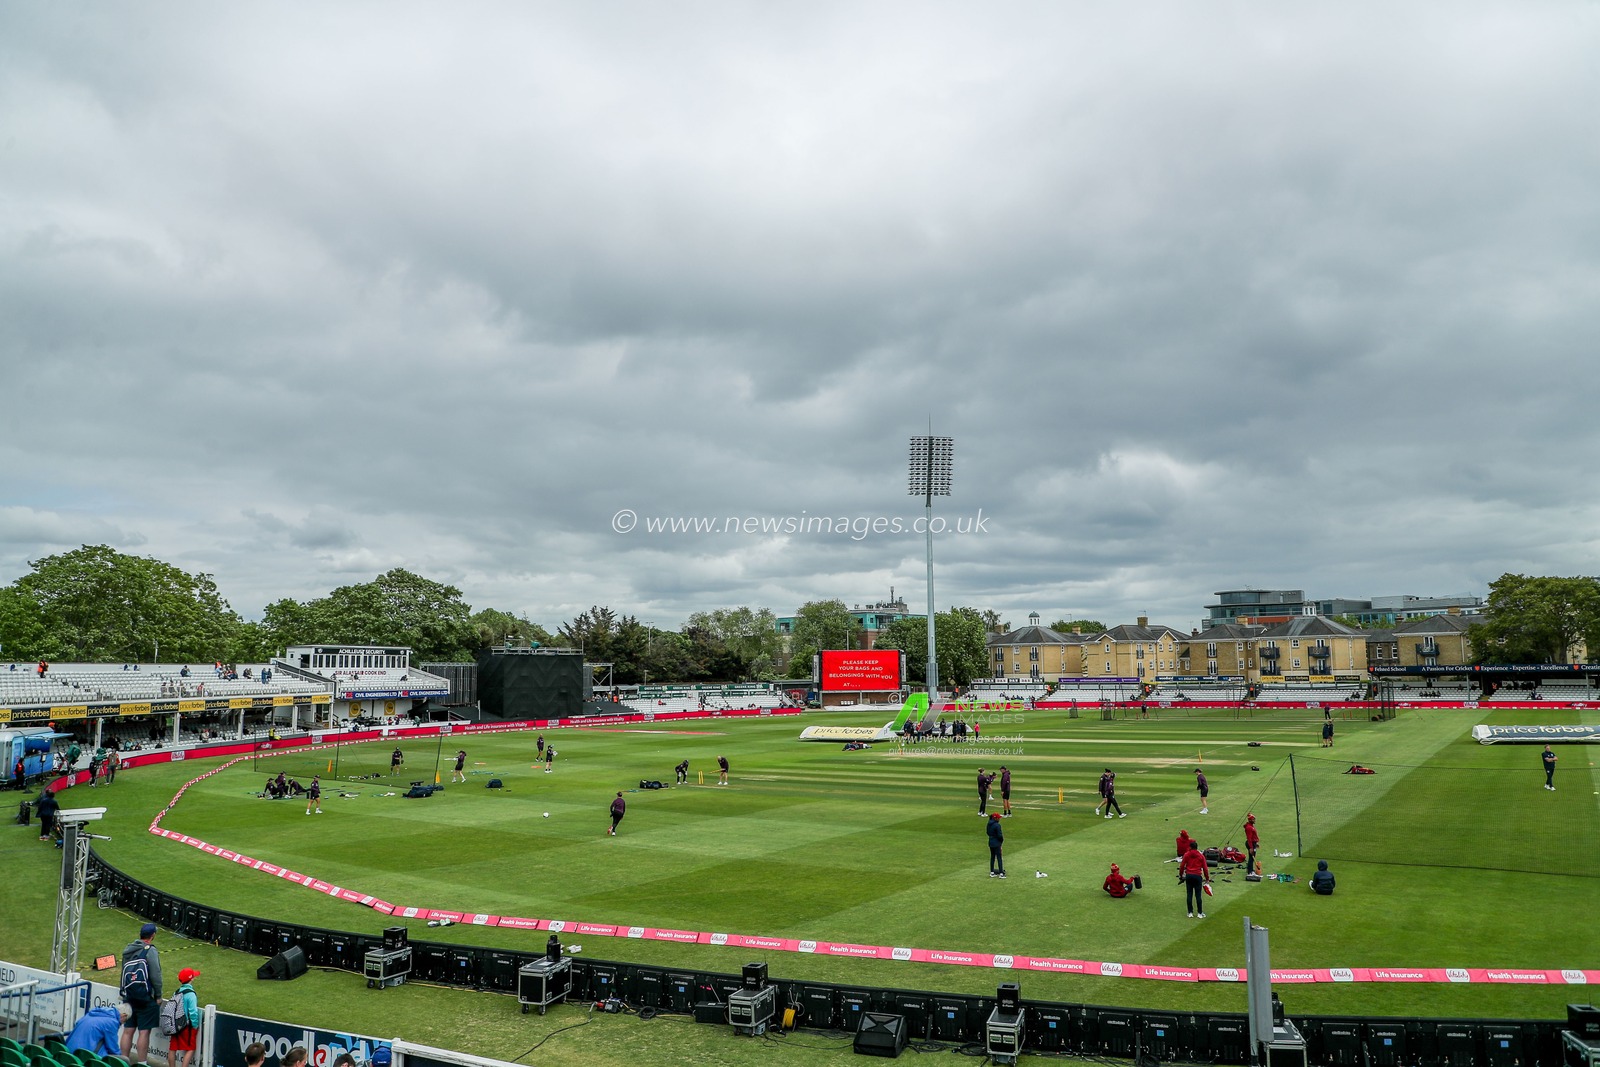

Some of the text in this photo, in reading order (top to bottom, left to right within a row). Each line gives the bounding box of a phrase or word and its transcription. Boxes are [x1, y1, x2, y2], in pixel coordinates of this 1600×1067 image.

[850, 947, 876, 955] insurance
[994, 956, 1014, 966] Vitality
[1052, 962, 1083, 970] insurance
[1101, 964, 1122, 975] Vitality
[1160, 970, 1192, 978] insurance
[1217, 969, 1238, 980] Vitality
[1332, 970, 1352, 980] Vitality
[1447, 970, 1469, 981] Vitality
[1564, 971, 1586, 982] Vitality
